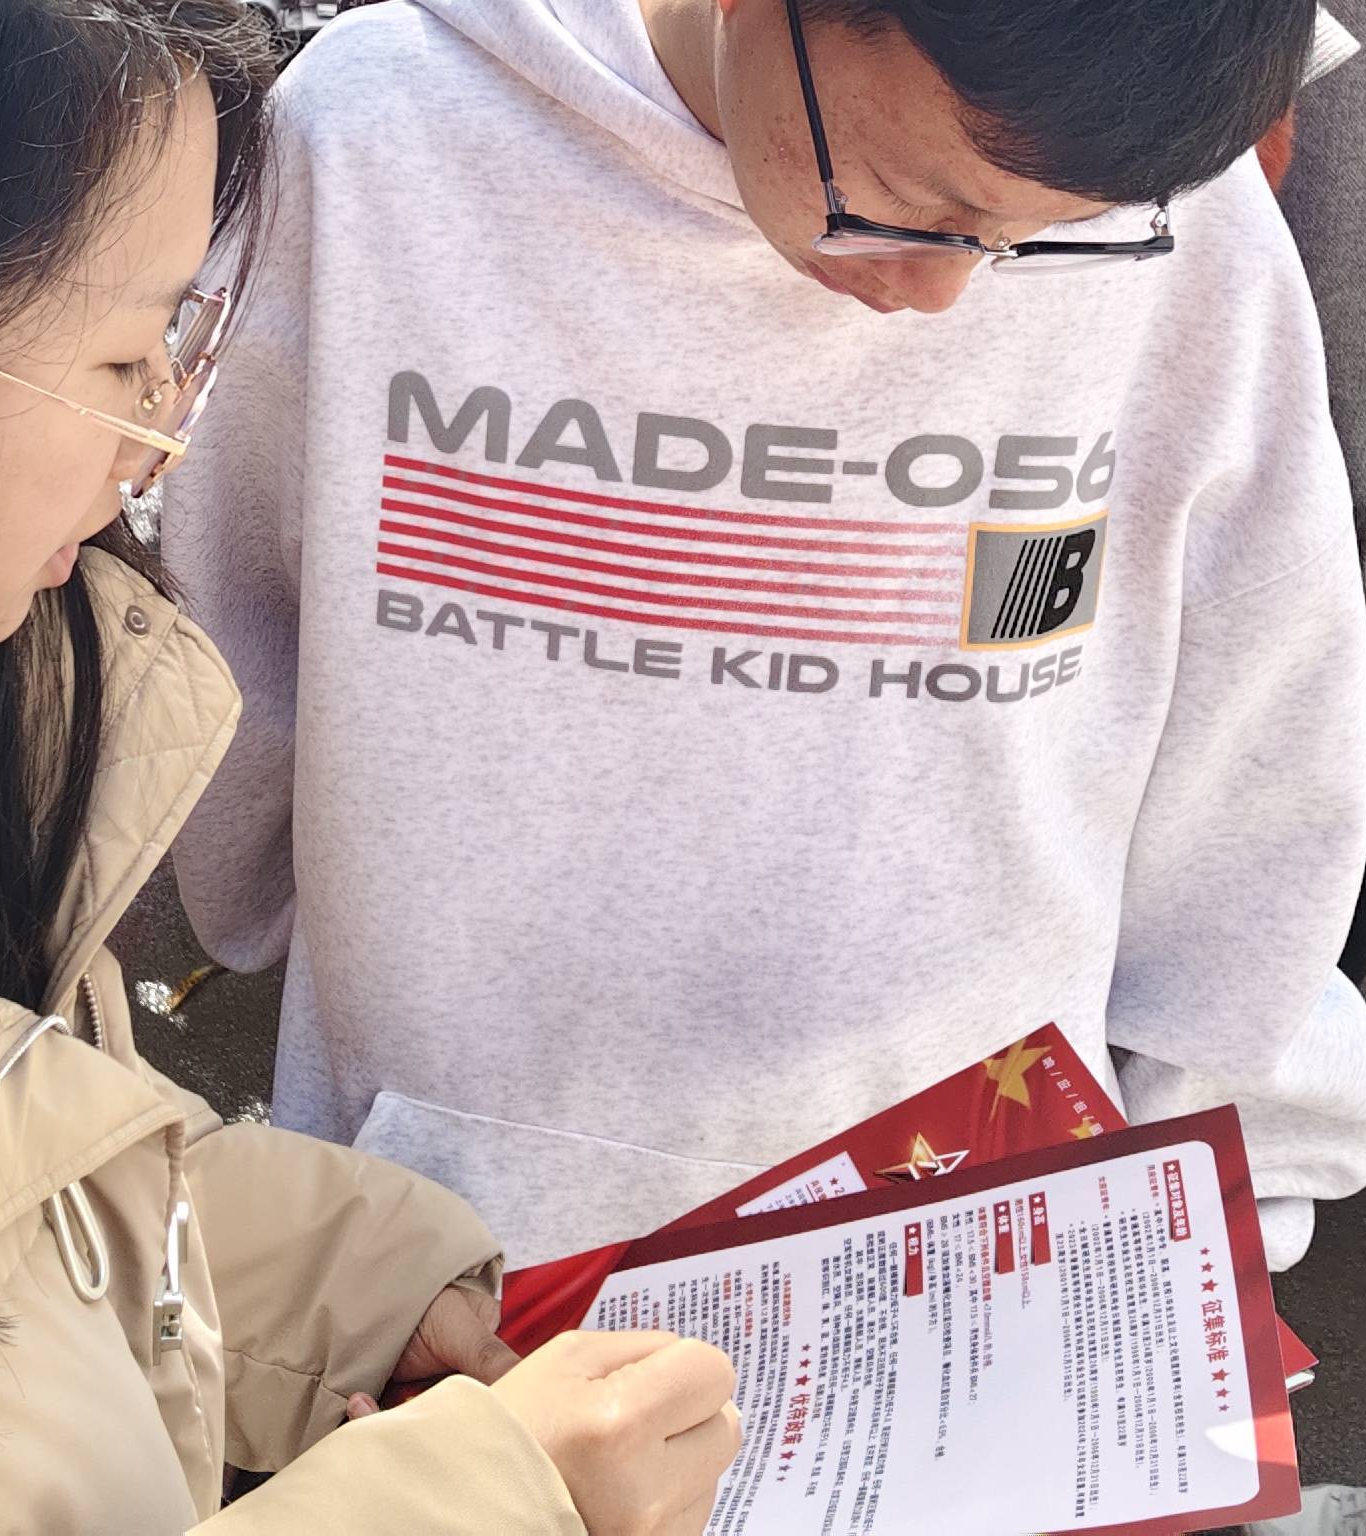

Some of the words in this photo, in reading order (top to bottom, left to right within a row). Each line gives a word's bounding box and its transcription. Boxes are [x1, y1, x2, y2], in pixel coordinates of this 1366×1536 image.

[387, 370, 1115, 511] MADE-056
[376, 589, 682, 680] BATTLE
[710, 646, 842, 695] KID
[997, 1215, 1009, 1234] 体重
[1032, 1207, 1044, 1225] 身高
[907, 1236, 918, 1256] 视力
[1200, 1299, 1229, 1363] 征集标准
[781, 1392, 810, 1446] 优待政策
